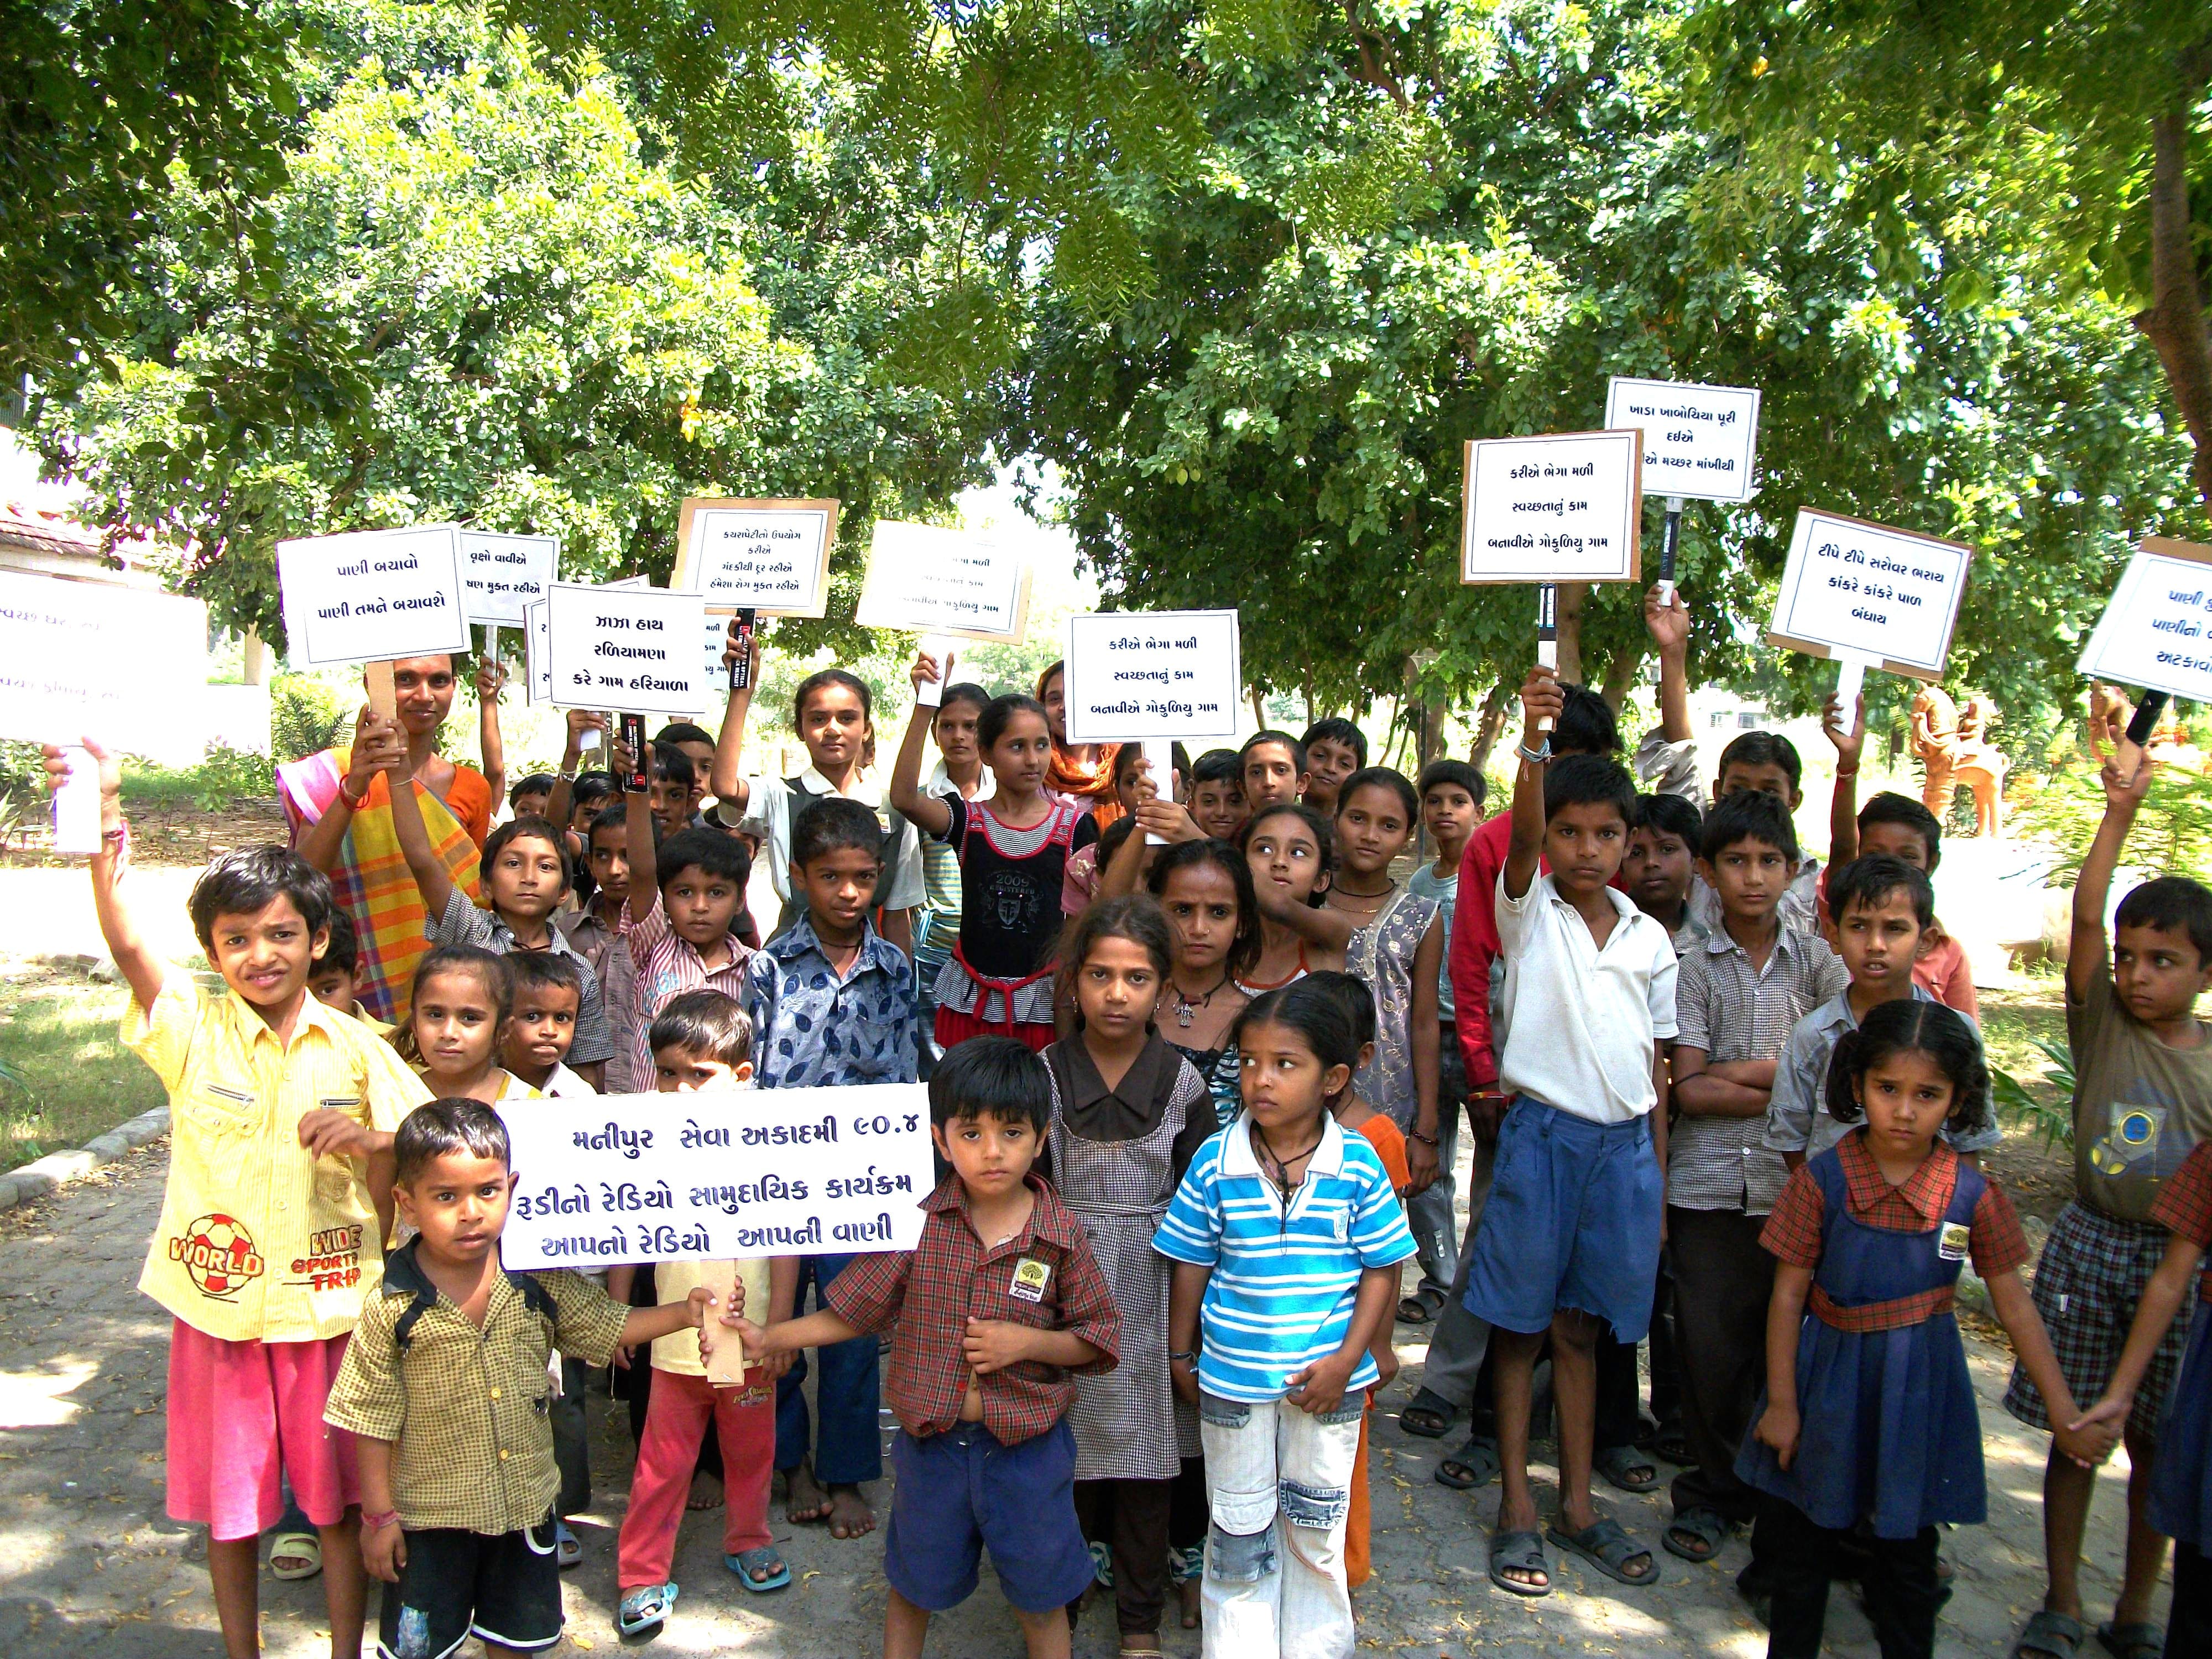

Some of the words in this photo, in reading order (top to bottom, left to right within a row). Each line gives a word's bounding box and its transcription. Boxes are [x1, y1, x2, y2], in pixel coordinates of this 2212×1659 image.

[1630, 405, 1655, 416] ખાડા
[1660, 405, 1713, 421] ખાબોચિયા
[1718, 410, 1736, 427] પૂરી
[1510, 463, 1540, 479] કરીએ
[1544, 462, 1567, 477] ભેગા
[1572, 462, 1593, 476] મળી
[1662, 457, 1692, 468] મચ્છર
[1512, 498, 1564, 517] સ્વચ્છતાનું
[1568, 501, 1587, 511] કામ
[771, 529, 801, 540] ઉપયોગ
[1488, 533, 1533, 549] બનાવીએ
[1538, 533, 1583, 553] ગોકુળિયુ
[1588, 538, 1608, 547] ગામ
[470, 549, 491, 564] વૃક્ષો
[494, 552, 526, 565] વાવીએ
[748, 544, 771, 554] કરીએ
[336, 559, 368, 576] પાણી
[374, 553, 418, 572] બચાવો
[755, 565, 766, 575] દૂર
[769, 562, 792, 572] રહીએ
[1818, 543, 1840, 559] ટીપે
[1844, 549, 1865, 565] ટીપે
[1870, 556, 1907, 575] સરોવર
[1911, 568, 1944, 583] ભરાય
[513, 582, 540, 594] રહીએ
[710, 577, 732, 588] હંમેશા
[735, 578, 750, 588] રોગ
[776, 580, 799, 590] રહીએ
[1828, 575, 1859, 592] કાંકરે
[1864, 583, 1893, 600] કાંકરે
[1898, 593, 1922, 607] પાળ
[317, 602, 349, 619] પાણી
[355, 597, 388, 615] તમને
[393, 591, 446, 611] બચાવશે
[2169, 591, 2204, 605] પાણી
[982, 604, 999, 613] ગામ
[1851, 607, 1887, 625] બંધાય
[596, 616, 630, 629] ઝાઝા
[636, 619, 664, 631] હાથ
[2152, 619, 2202, 638] પાણીનો
[594, 641, 666, 660] રળિયામણા
[1109, 637, 1140, 650] કરીએ
[1145, 636, 1170, 649] ભેગા
[1175, 636, 1197, 649] મળી
[572, 669, 592, 685] કરે
[598, 676, 624, 688] ગામ
[629, 675, 688, 692] હરિયાળા
[1114, 667, 1169, 685] સ્વચ્છતાનું
[1174, 671, 1193, 680] કામ
[1091, 700, 1140, 714] બનાવીએ
[1145, 700, 1193, 718] ગોકુળિયુ
[1197, 703, 1218, 712] ગામ
[572, 1121, 654, 1160] મનીપુર
[680, 1118, 731, 1149] સેવા
[741, 1115, 838, 1146] અકાદમી
[853, 1114, 919, 1135] ૯૦.૪
[516, 1182, 591, 1220] રૂડીનો
[600, 1180, 674, 1212] રેડિયો
[689, 1173, 808, 1215] સામુદાયિક
[825, 1165, 912, 1199] કાર્યક્રમ
[310, 1224, 363, 1256] WIDE
[541, 1225, 628, 1256] આપનો
[638, 1223, 711, 1254] રેડિયો
[737, 1216, 823, 1247] આપની
[832, 1212, 893, 1242] વાણી
[169, 1237, 265, 1277] WORLD
[309, 1267, 361, 1292] TRIP
